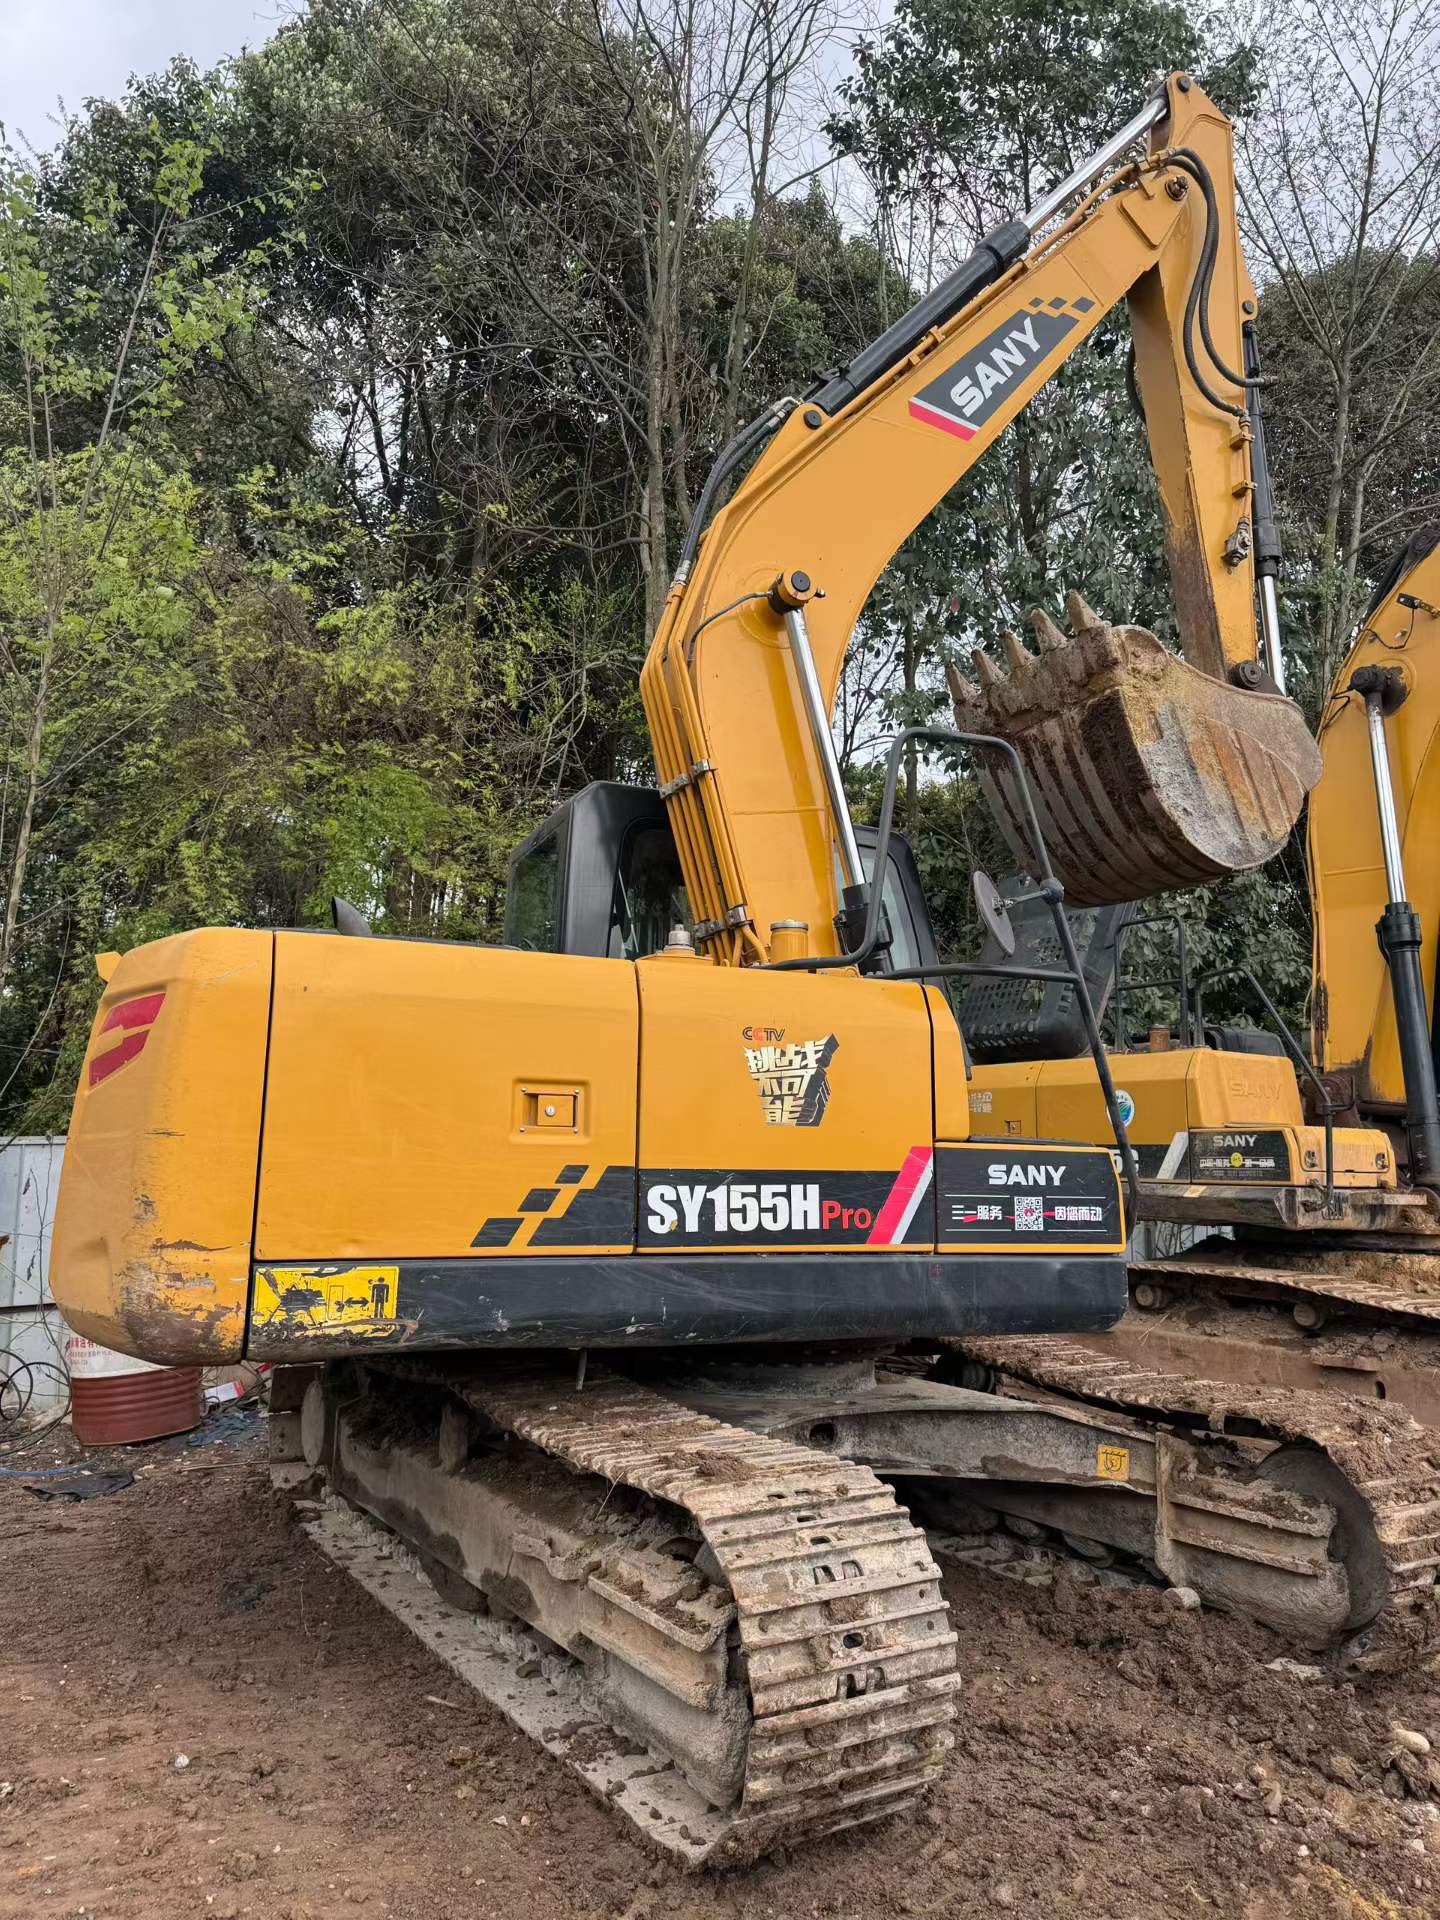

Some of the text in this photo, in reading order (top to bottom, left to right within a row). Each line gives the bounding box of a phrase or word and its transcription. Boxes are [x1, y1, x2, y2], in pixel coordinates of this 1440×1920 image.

[950, 316, 1041, 417] SANY
[742, 1026, 785, 1042] CCTV
[743, 1034, 832, 1073] 挑战
[751, 1068, 818, 1098] 不可
[759, 1096, 805, 1124] 能
[1213, 1134, 1257, 1147] SANY
[988, 1164, 1066, 1186] SANY
[647, 1184, 872, 1234] SY155H Pro
[951, 1204, 1003, 1221] 三一服务
